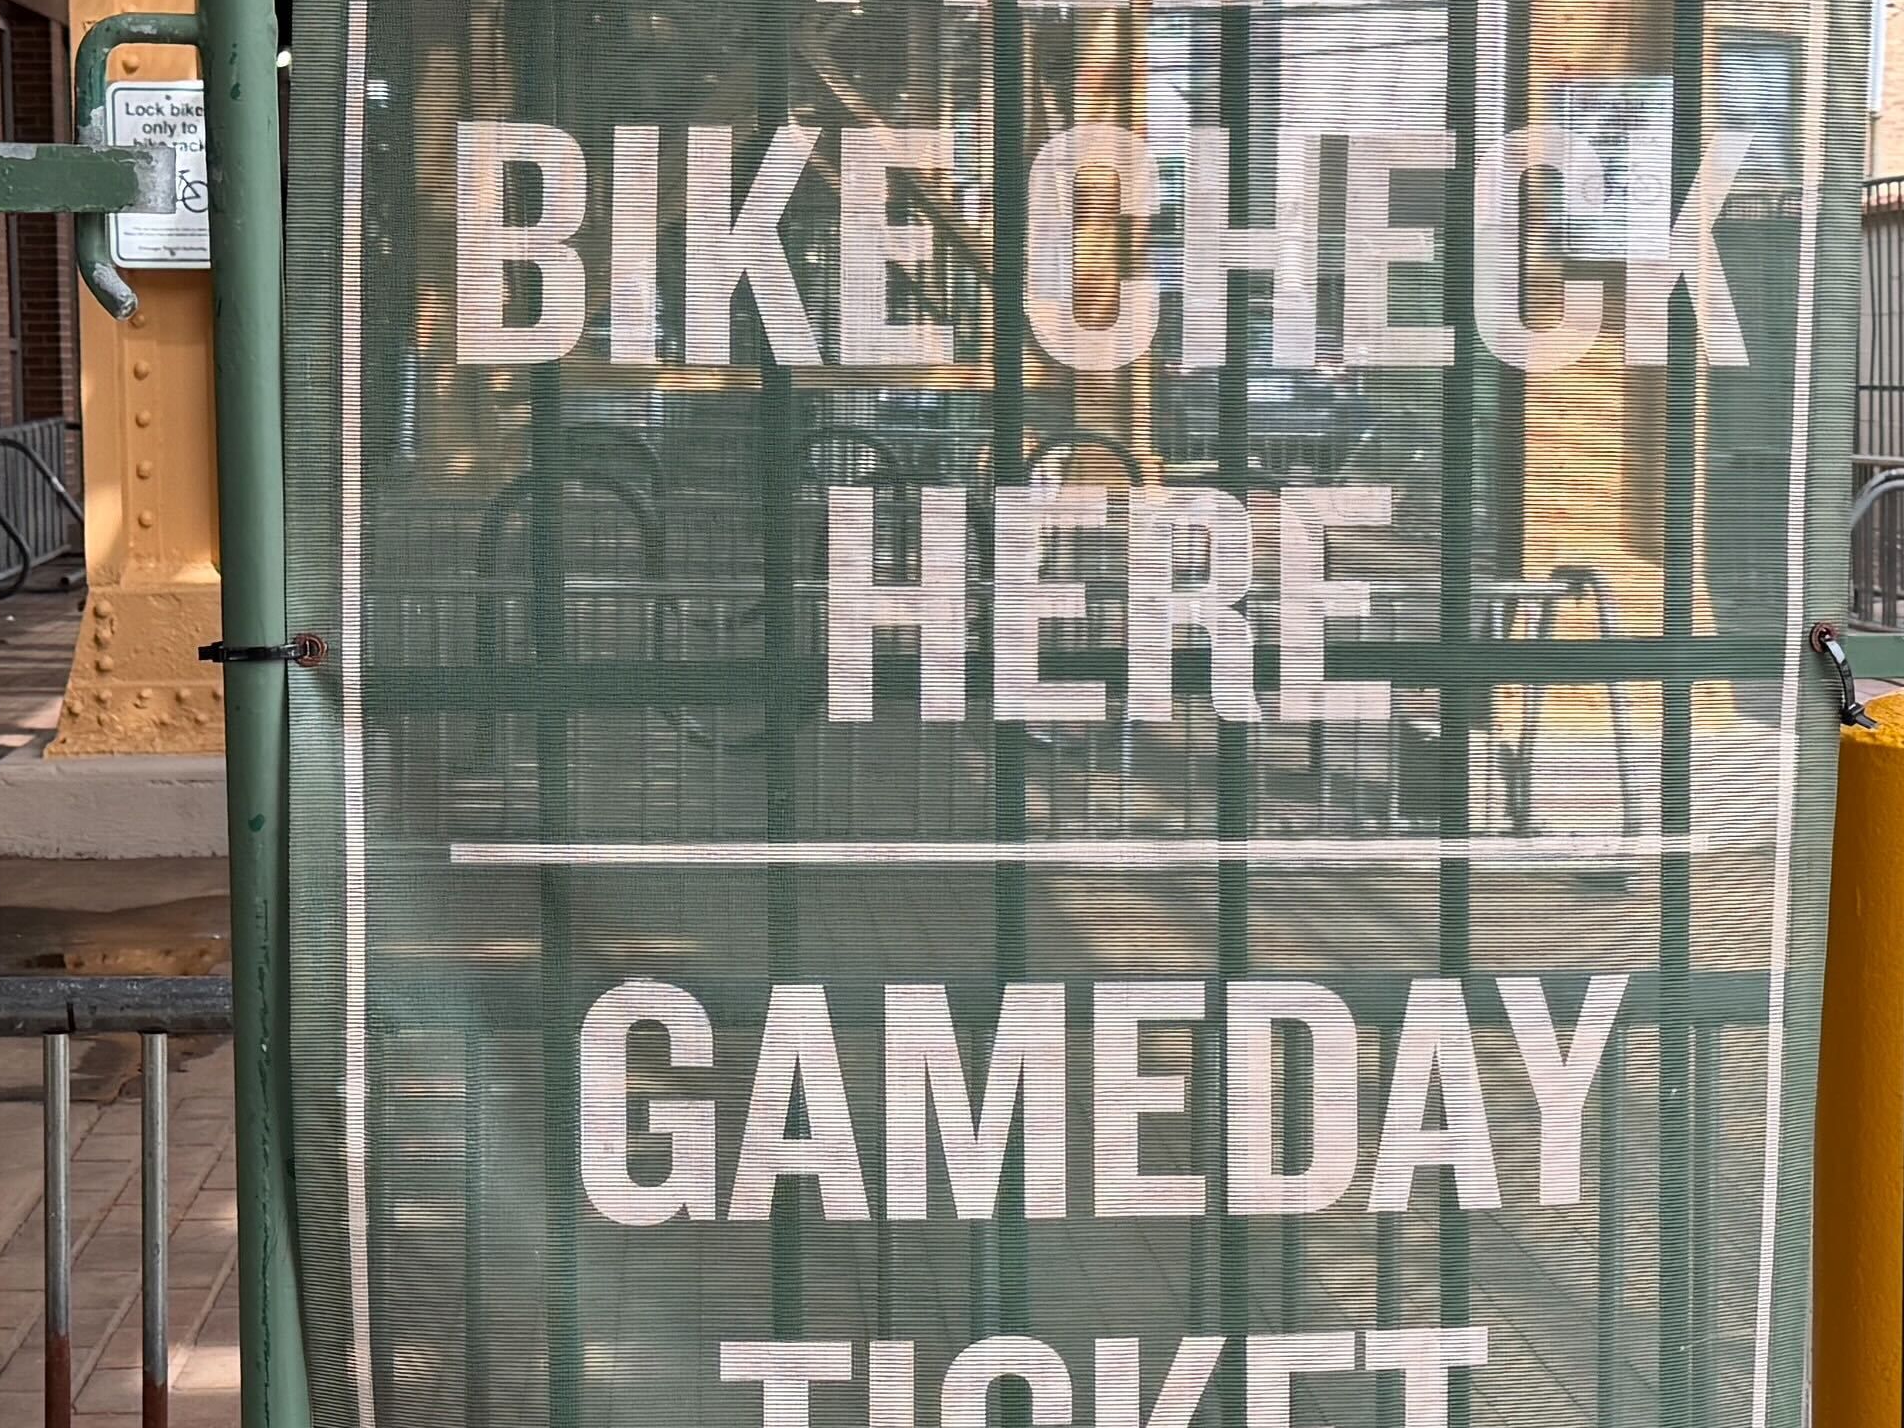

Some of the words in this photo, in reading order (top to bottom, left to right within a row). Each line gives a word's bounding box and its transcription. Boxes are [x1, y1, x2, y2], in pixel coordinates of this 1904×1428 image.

[125, 102, 165, 116] Lock
[142, 121, 176, 137] only
[181, 122, 198, 134] to
[455, 121, 956, 367] BIKE
[1022, 123, 1752, 369] CHECK
[827, 483, 1395, 724] HERE
[577, 974, 1632, 1228] GAMEDAY
